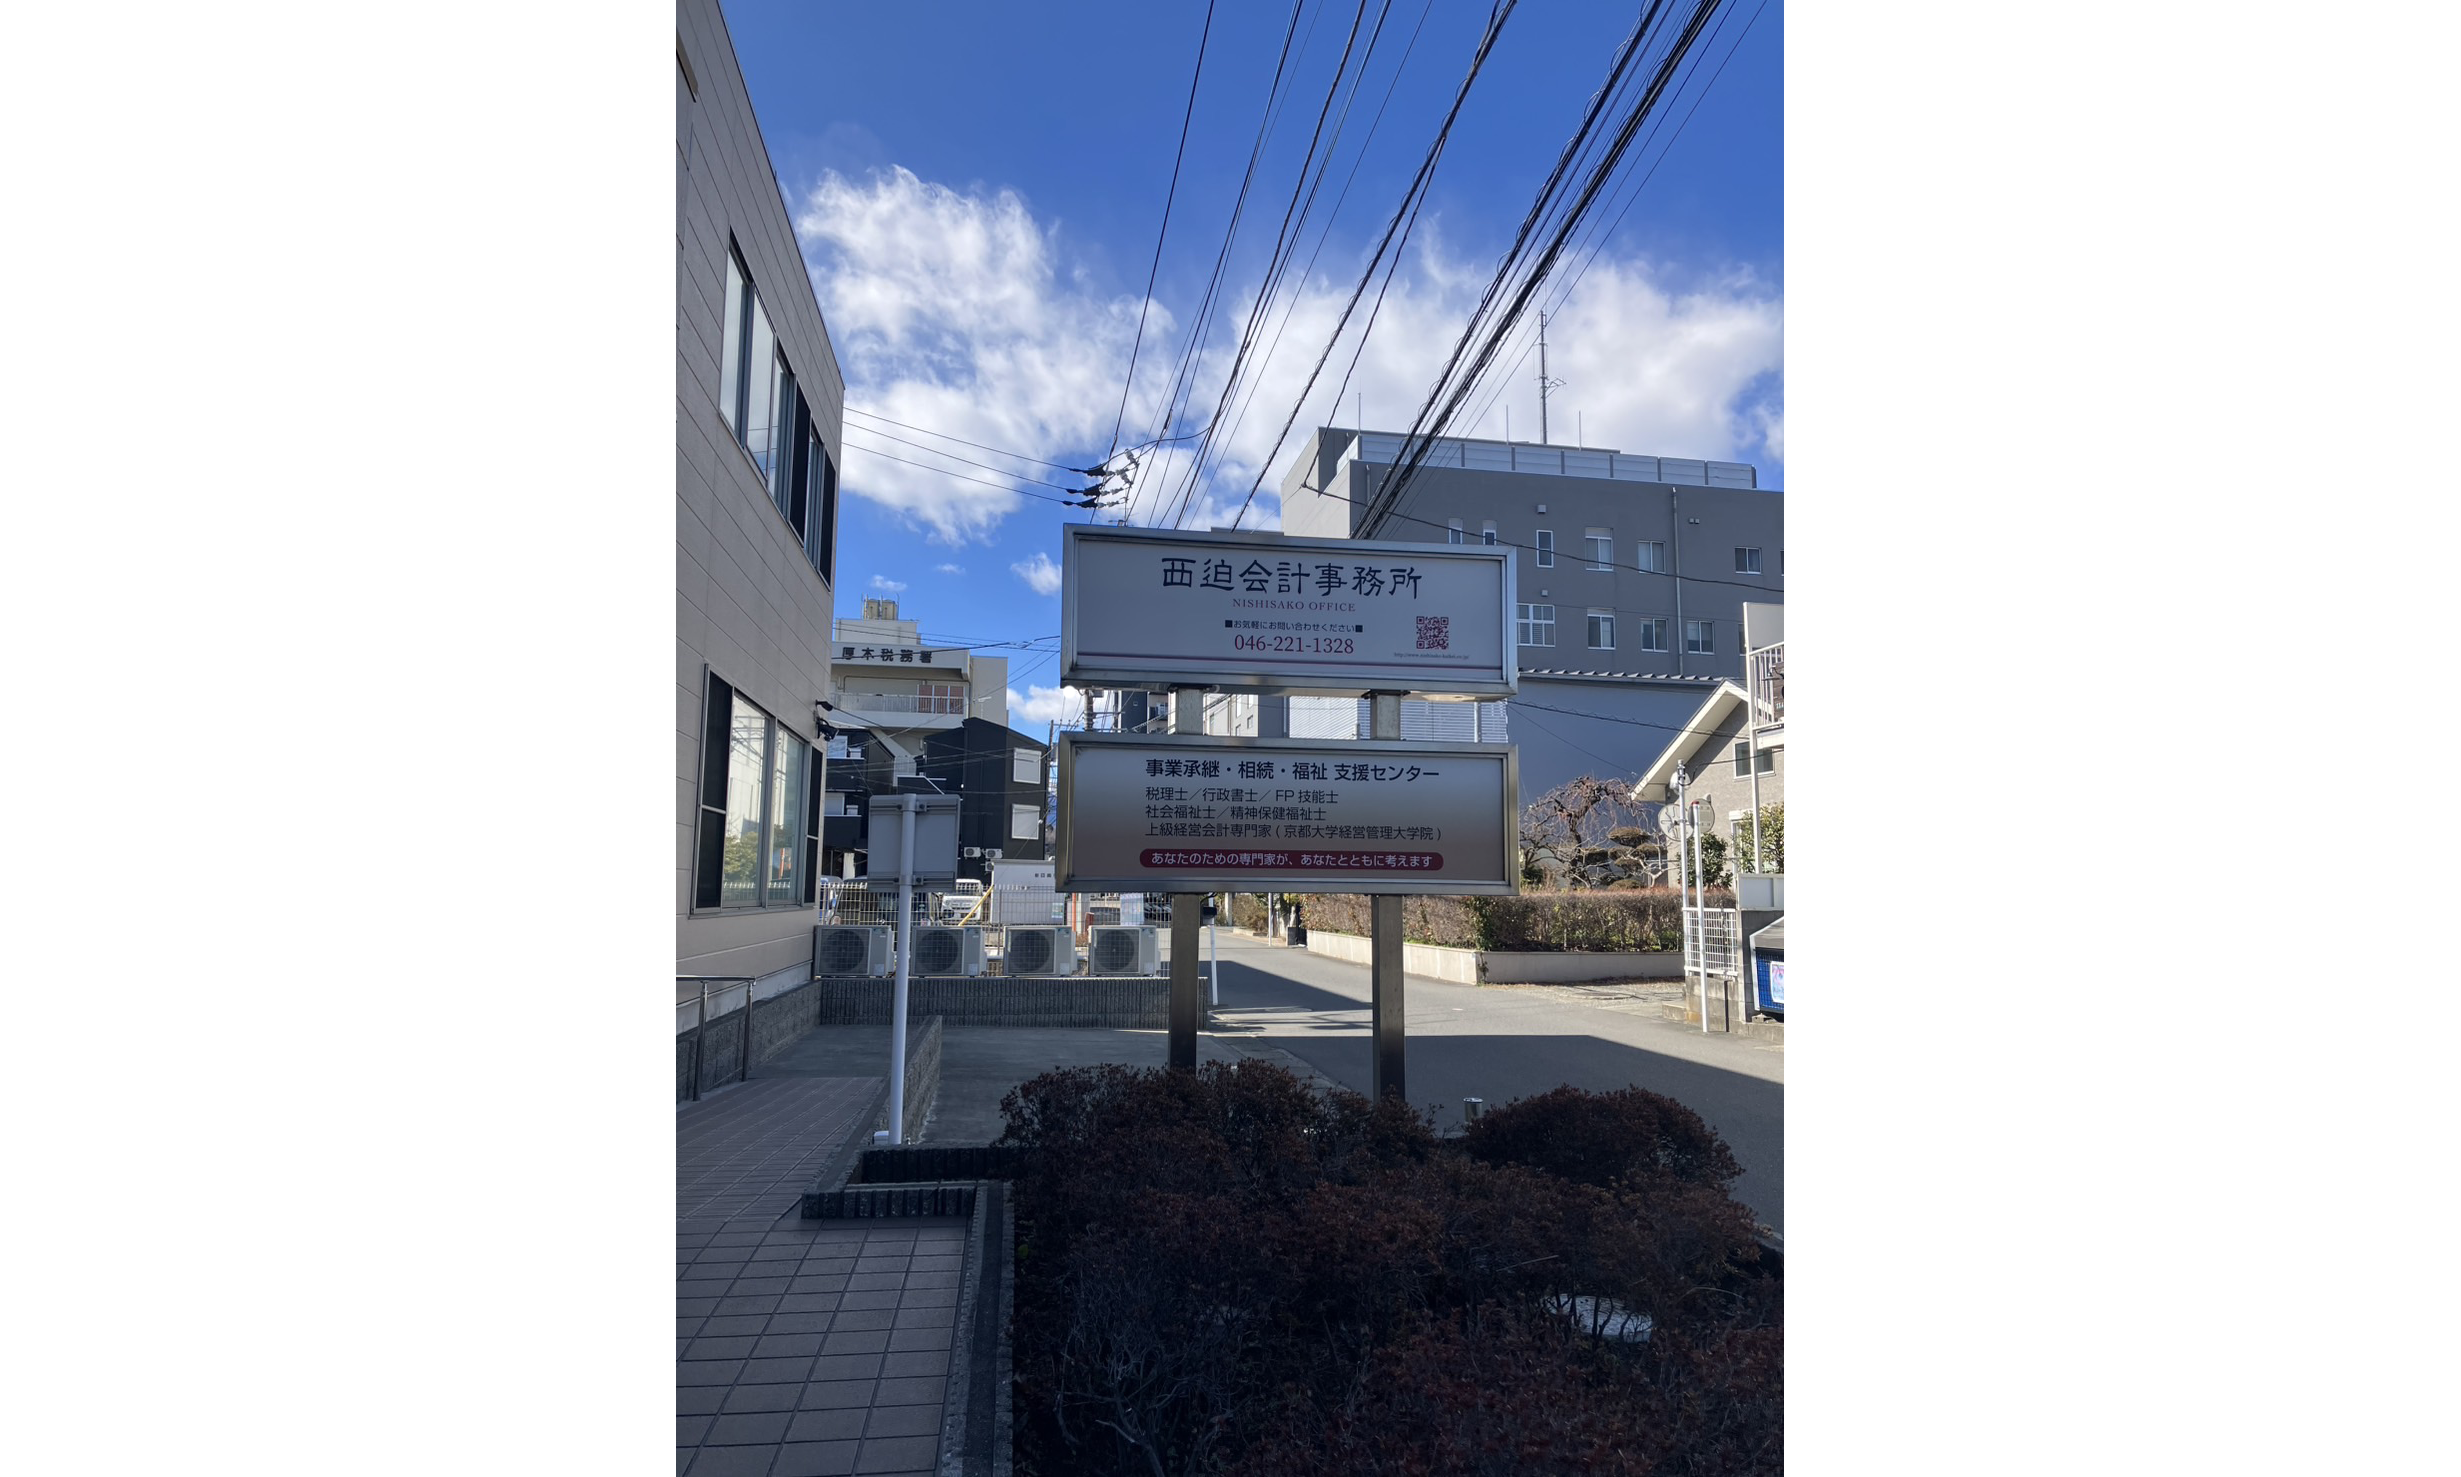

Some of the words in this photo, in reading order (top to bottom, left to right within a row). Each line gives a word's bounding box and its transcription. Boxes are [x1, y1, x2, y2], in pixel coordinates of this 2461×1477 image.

[1161, 557, 1423, 600] 西迫会計事務所
[1232, 598, 1305, 610] NISHISAKO
[1308, 601, 1356, 612] OFFICE
[1234, 634, 1354, 654] 046-221-1328
[842, 646, 933, 664] 厚木税務署
[1145, 758, 1328, 781] 事業承継・相続・福祉
[1334, 762, 1440, 782] 支援センター
[1275, 789, 1295, 802] FP
